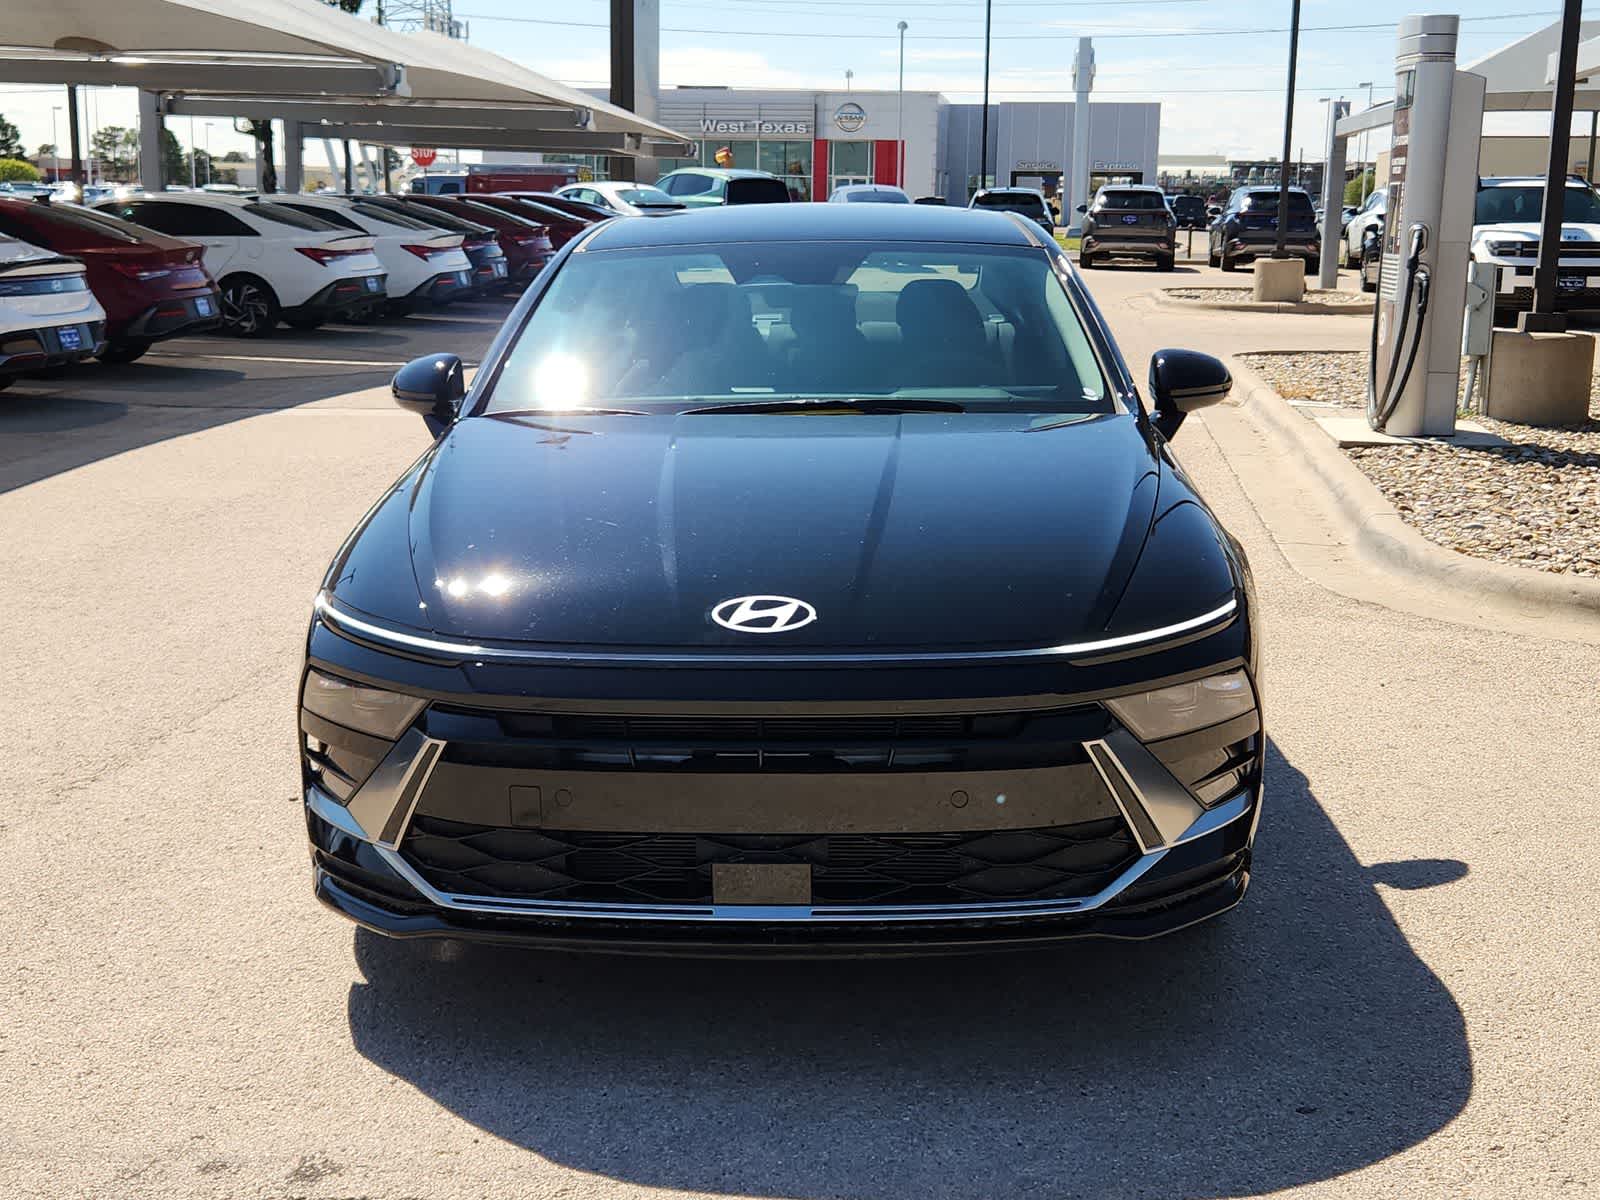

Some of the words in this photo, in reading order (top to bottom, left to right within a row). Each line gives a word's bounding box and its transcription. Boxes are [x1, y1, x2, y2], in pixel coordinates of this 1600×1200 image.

[699, 119, 746, 133] West
[753, 120, 808, 134] Texas
[411, 148, 434, 158] STOP
